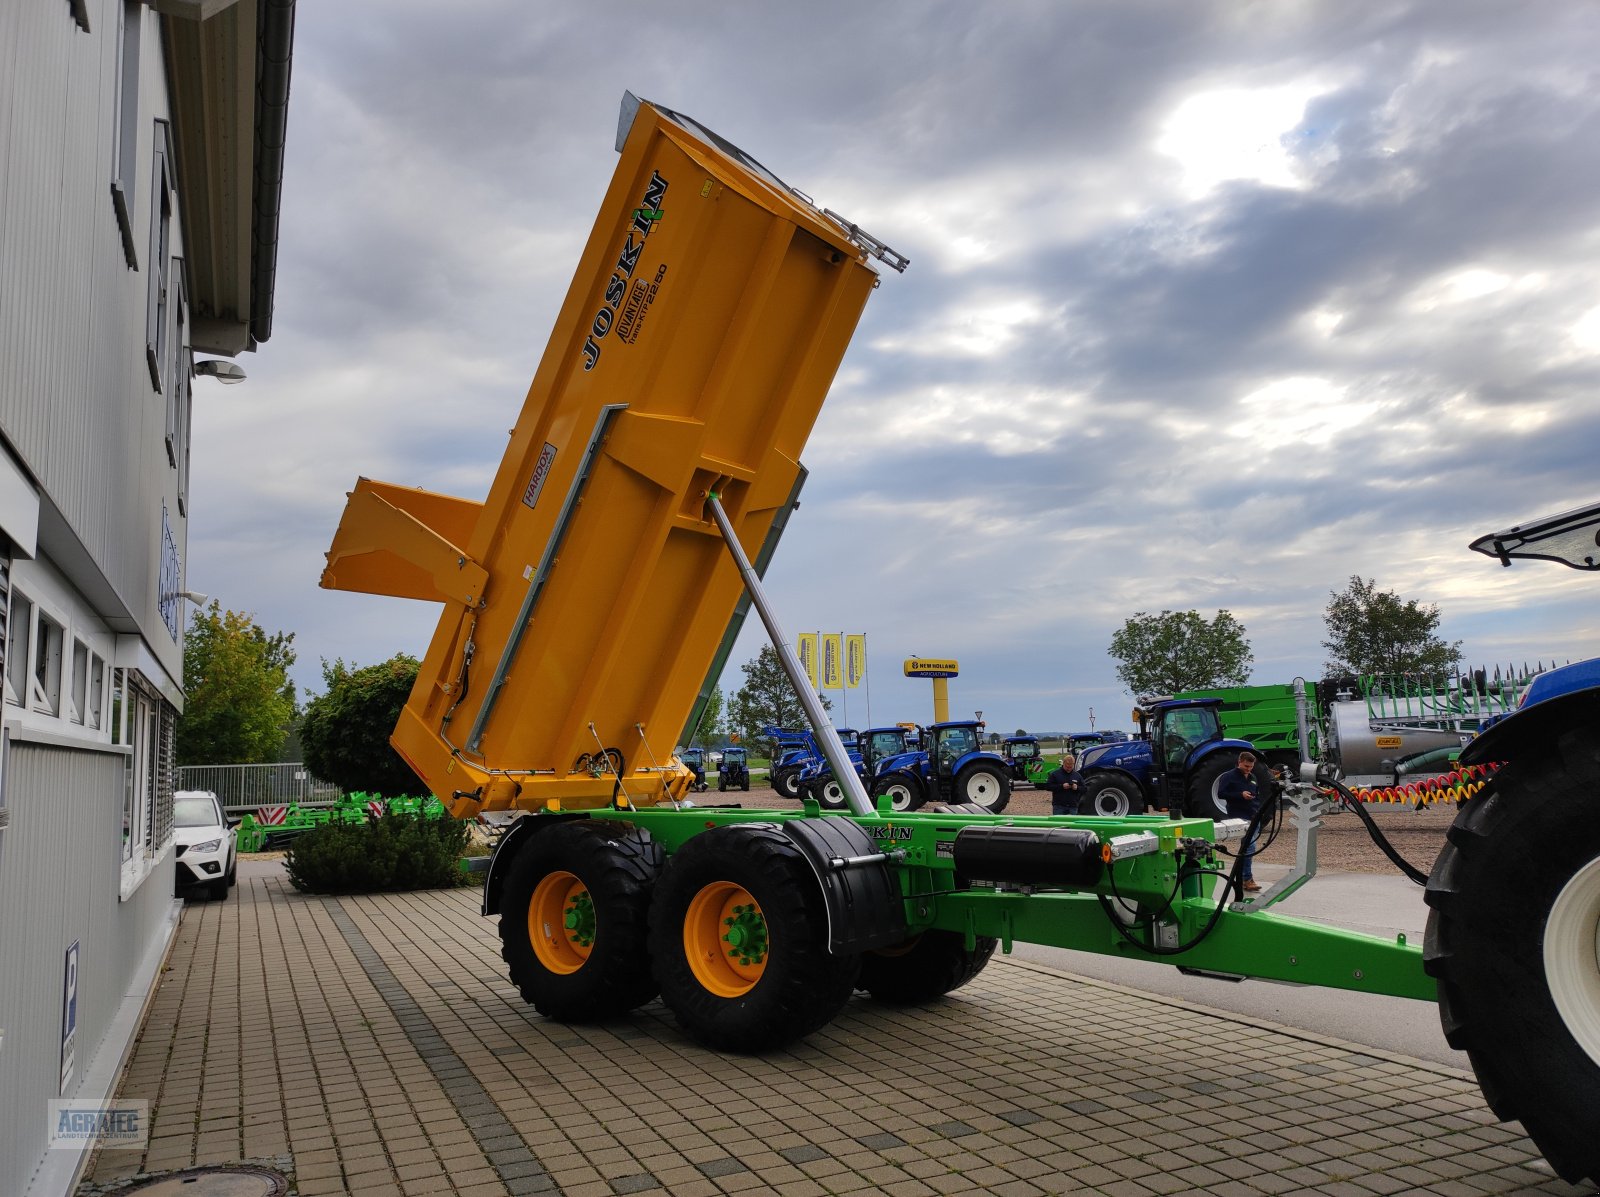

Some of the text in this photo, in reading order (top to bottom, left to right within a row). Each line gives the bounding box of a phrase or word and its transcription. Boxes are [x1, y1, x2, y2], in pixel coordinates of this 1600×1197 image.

[581, 169, 669, 372] JOSKIN
[627, 263, 668, 345] Trans-KTP 22/50
[616, 283, 646, 344] ADVANTAGE
[525, 446, 551, 503] HARDOX
